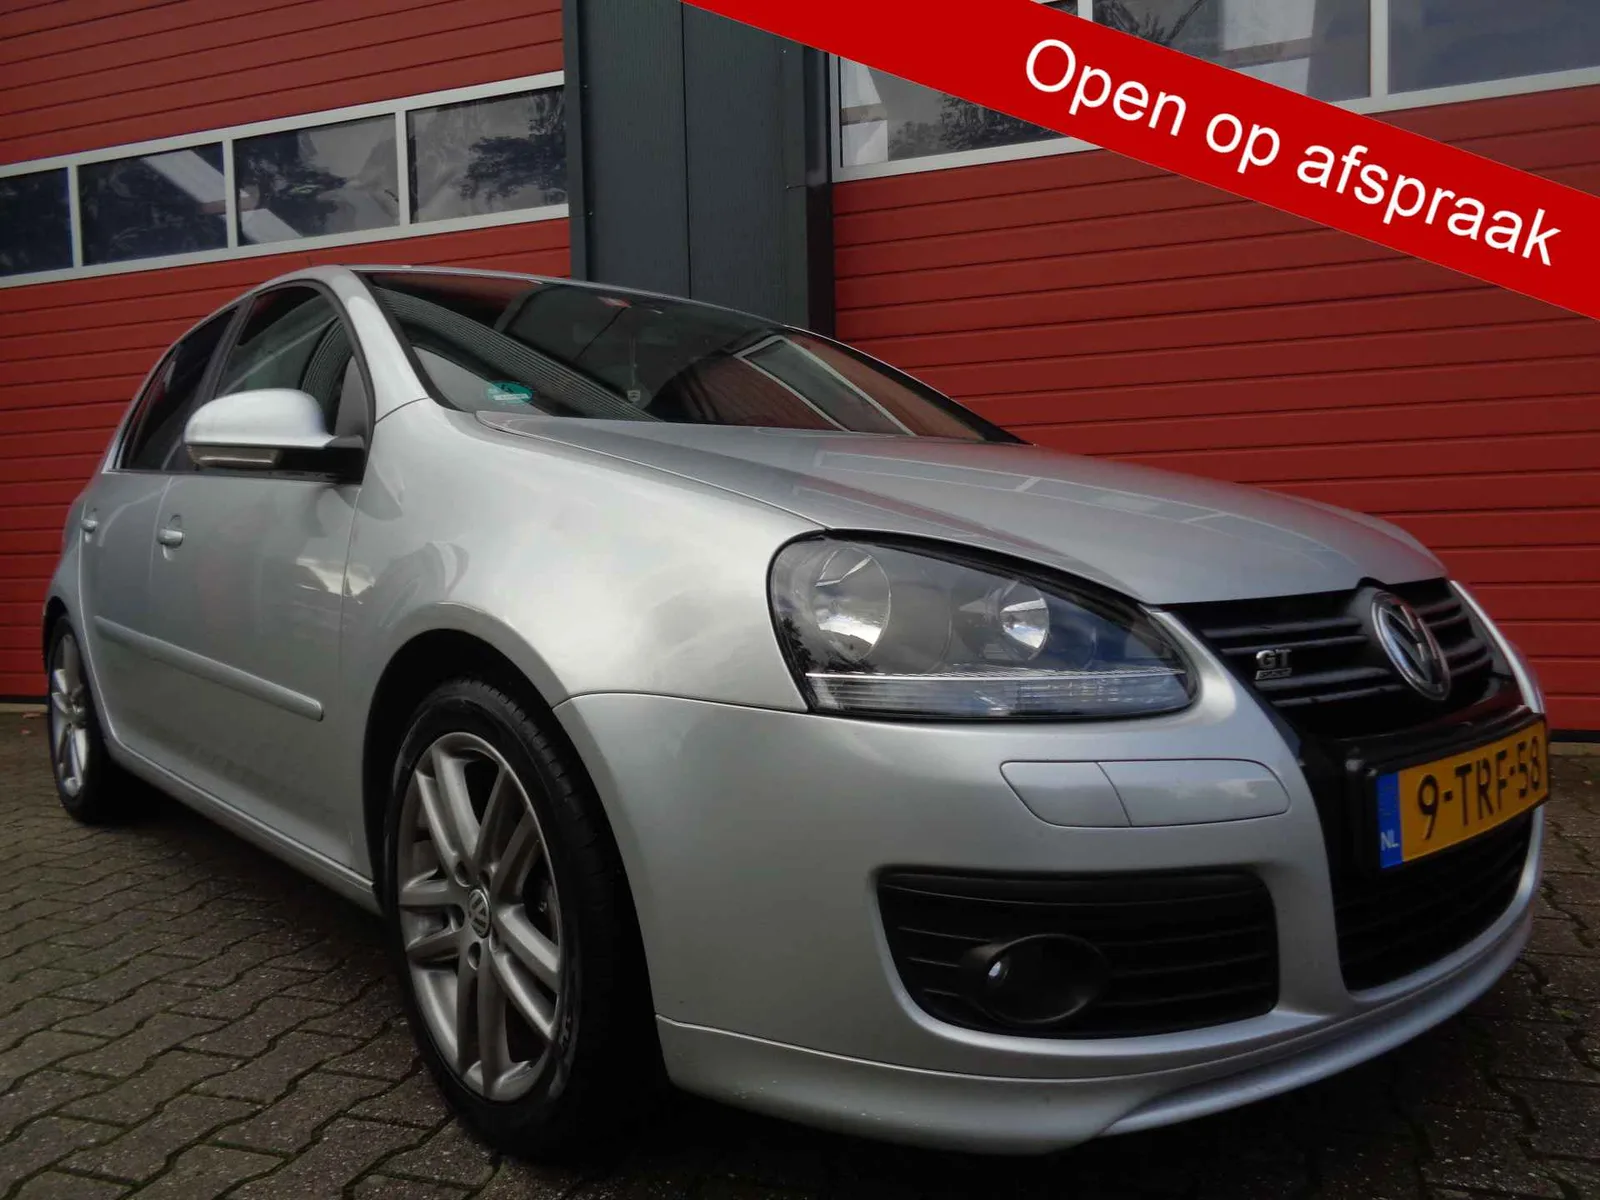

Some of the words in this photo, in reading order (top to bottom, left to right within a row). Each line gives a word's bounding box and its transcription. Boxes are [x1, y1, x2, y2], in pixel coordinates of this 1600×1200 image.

[1255, 649, 1292, 669] GT
[1417, 735, 1541, 841] 9-TRF-58
[1379, 829, 1400, 851] NL
